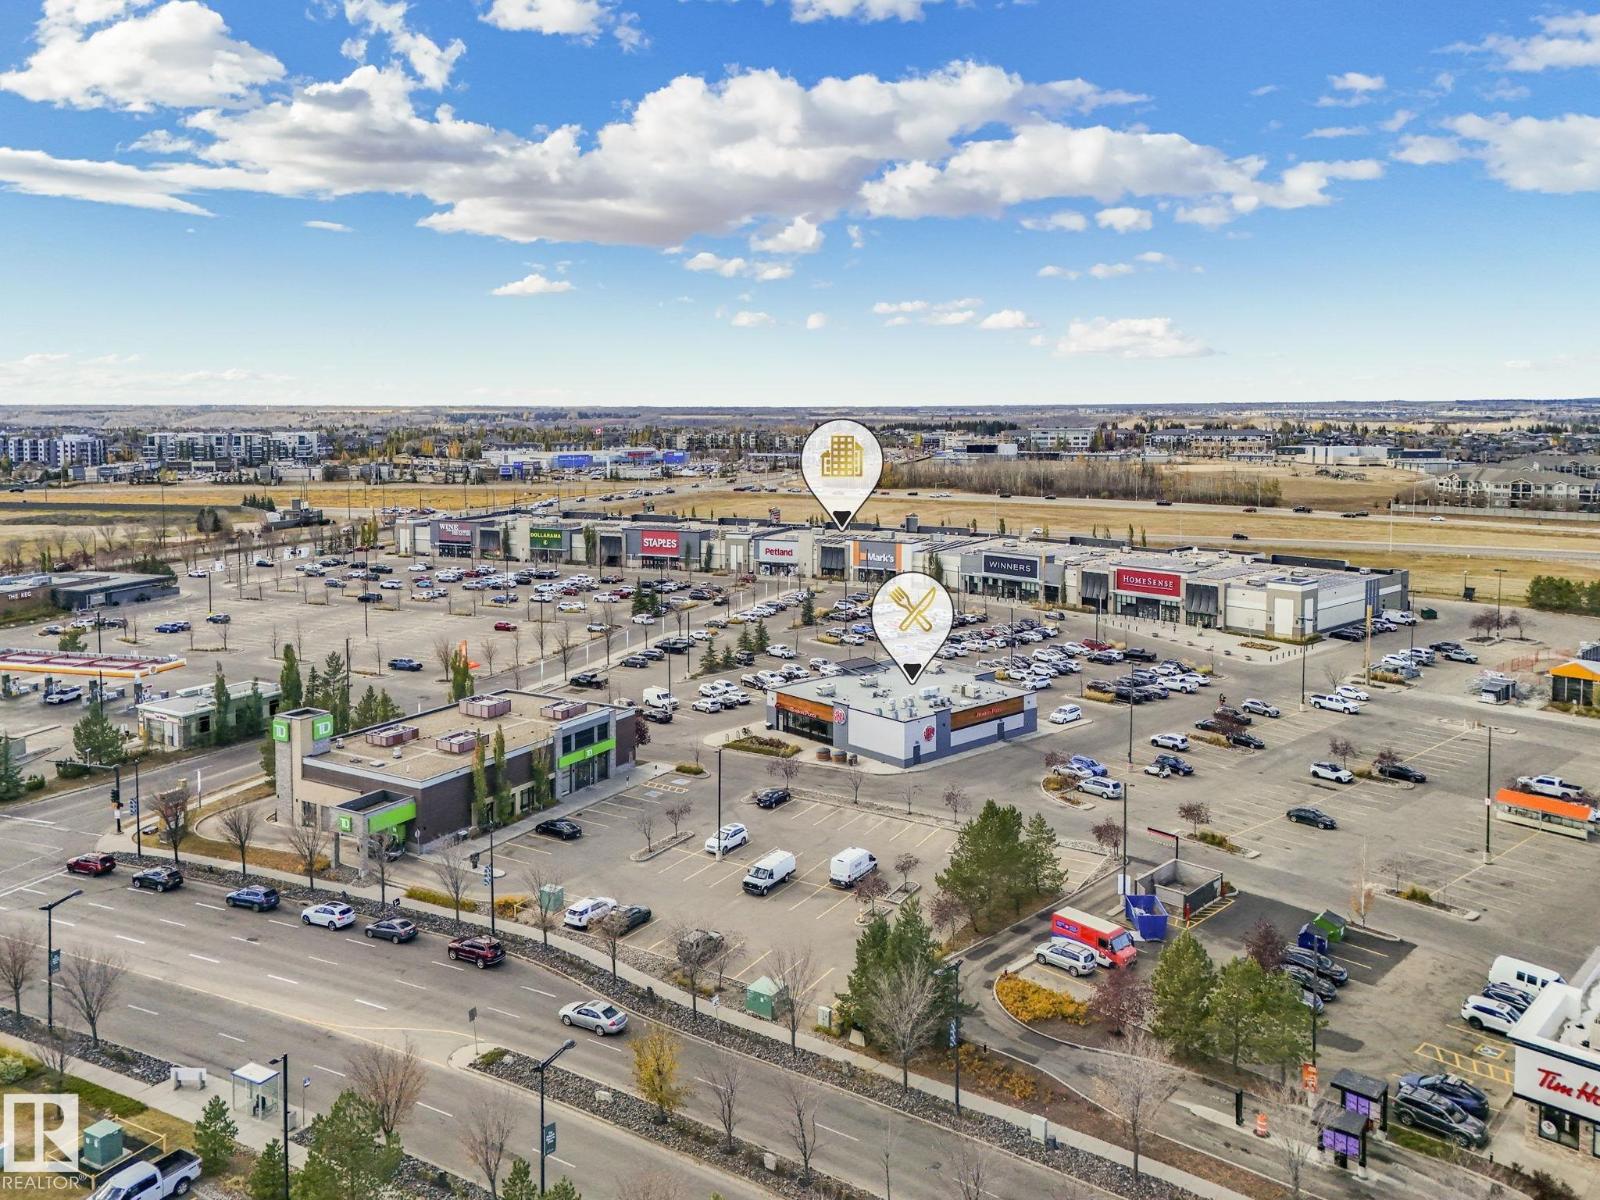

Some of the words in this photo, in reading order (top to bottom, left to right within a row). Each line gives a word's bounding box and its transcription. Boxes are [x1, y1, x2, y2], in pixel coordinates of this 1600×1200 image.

[643, 538, 678, 549] STAPLES
[765, 547, 793, 557] Petland
[868, 552, 895, 563] Mark's
[989, 560, 1032, 573] WINNERS
[8, 593, 19, 601] THE
[273, 724, 286, 738] TD
[315, 721, 331, 735] TD
[339, 817, 350, 830] TD
[1537, 1068, 1574, 1097] Tim
